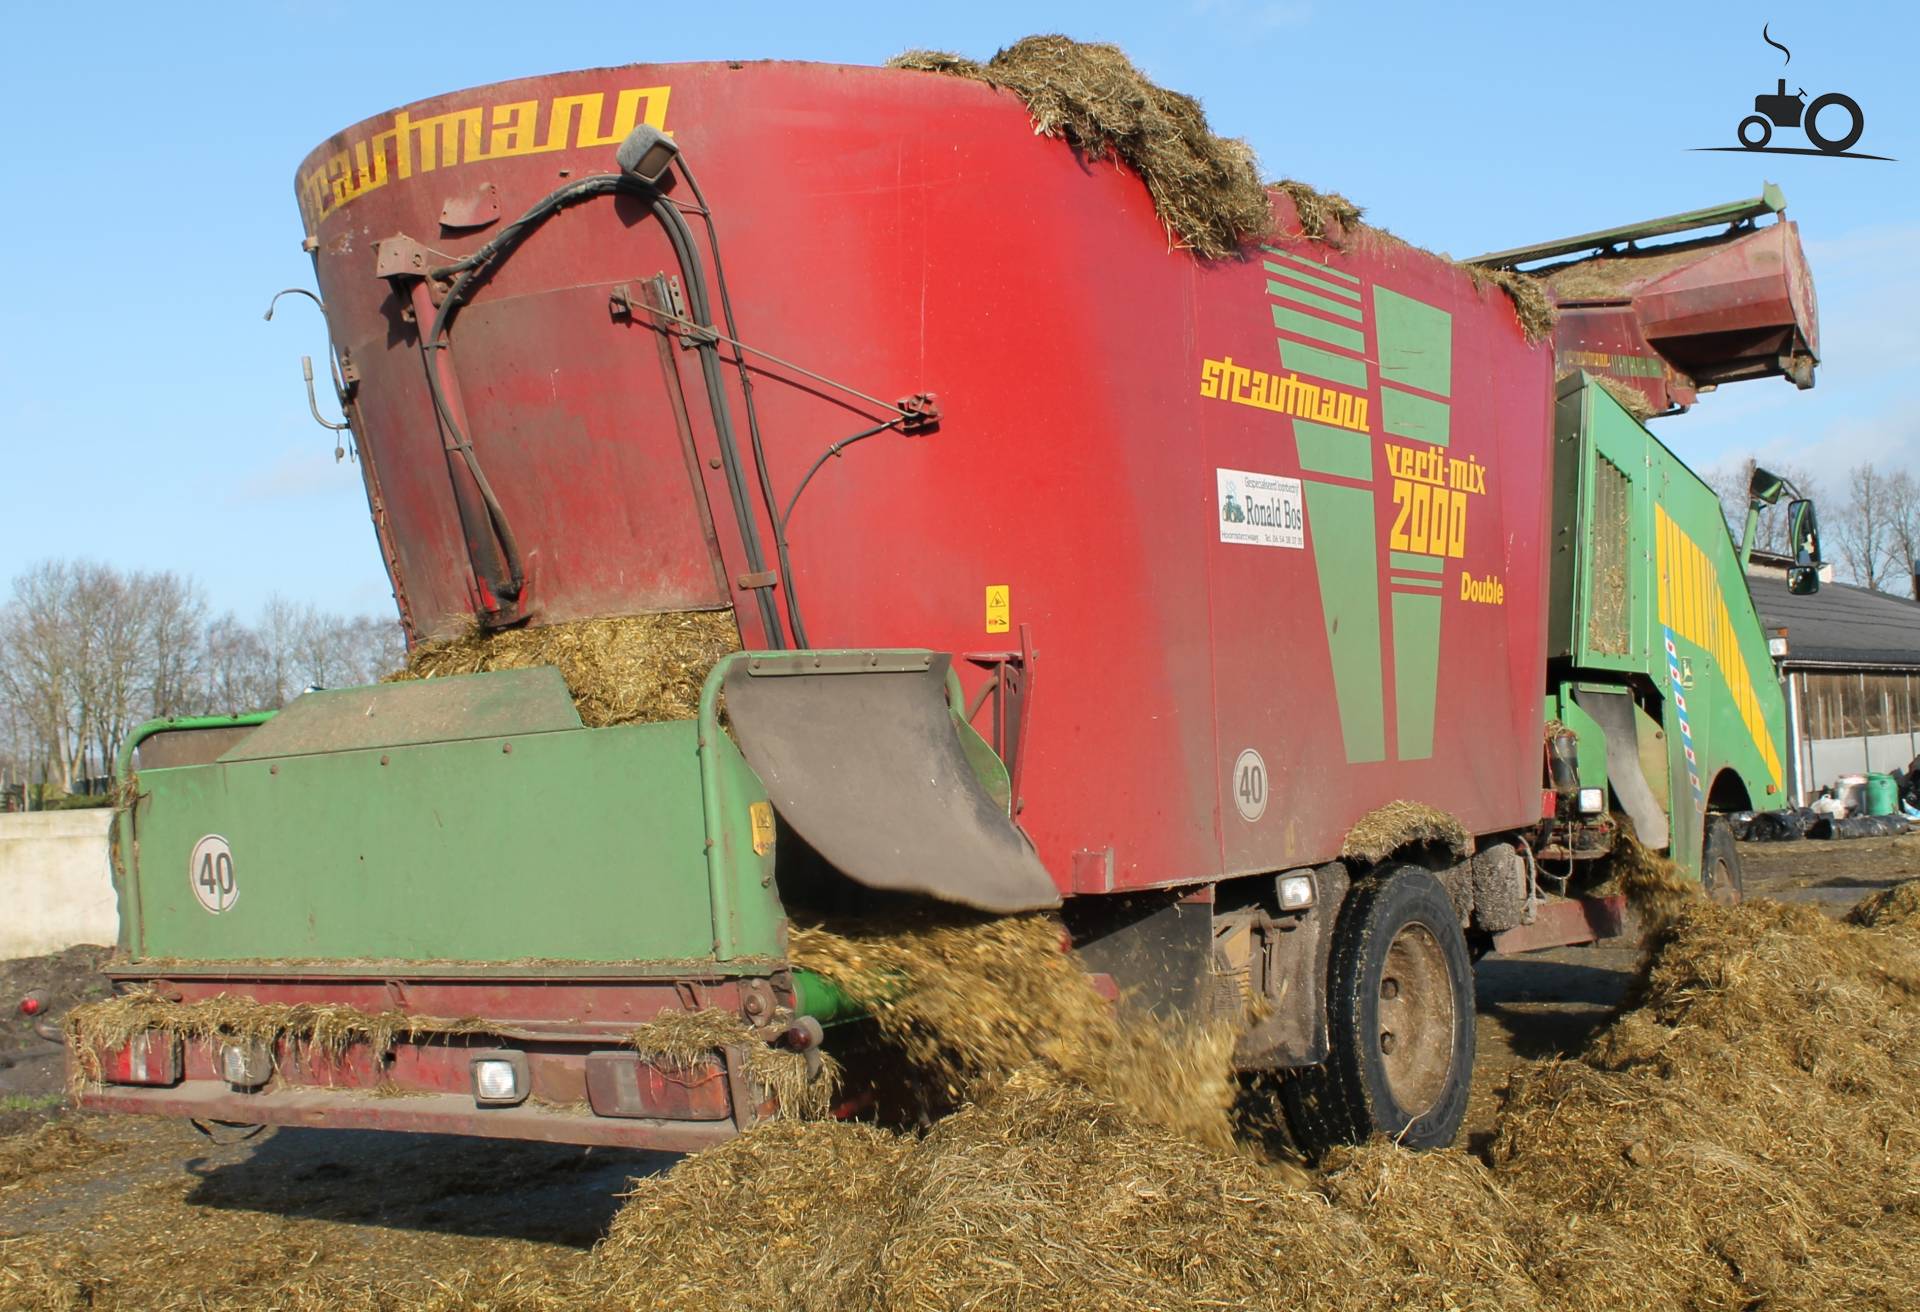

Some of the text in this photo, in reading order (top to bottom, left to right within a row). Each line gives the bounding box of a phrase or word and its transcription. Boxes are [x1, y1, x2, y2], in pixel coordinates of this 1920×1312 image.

[1200, 356, 1369, 432] strautmann
[1384, 443, 1486, 495] verti-mix
[1245, 495, 1301, 530] Ronald Bos
[1389, 479, 1467, 558] 2000
[1460, 571, 1504, 605] Double
[1240, 766, 1262, 804] 40
[200, 852, 233, 894] 40
